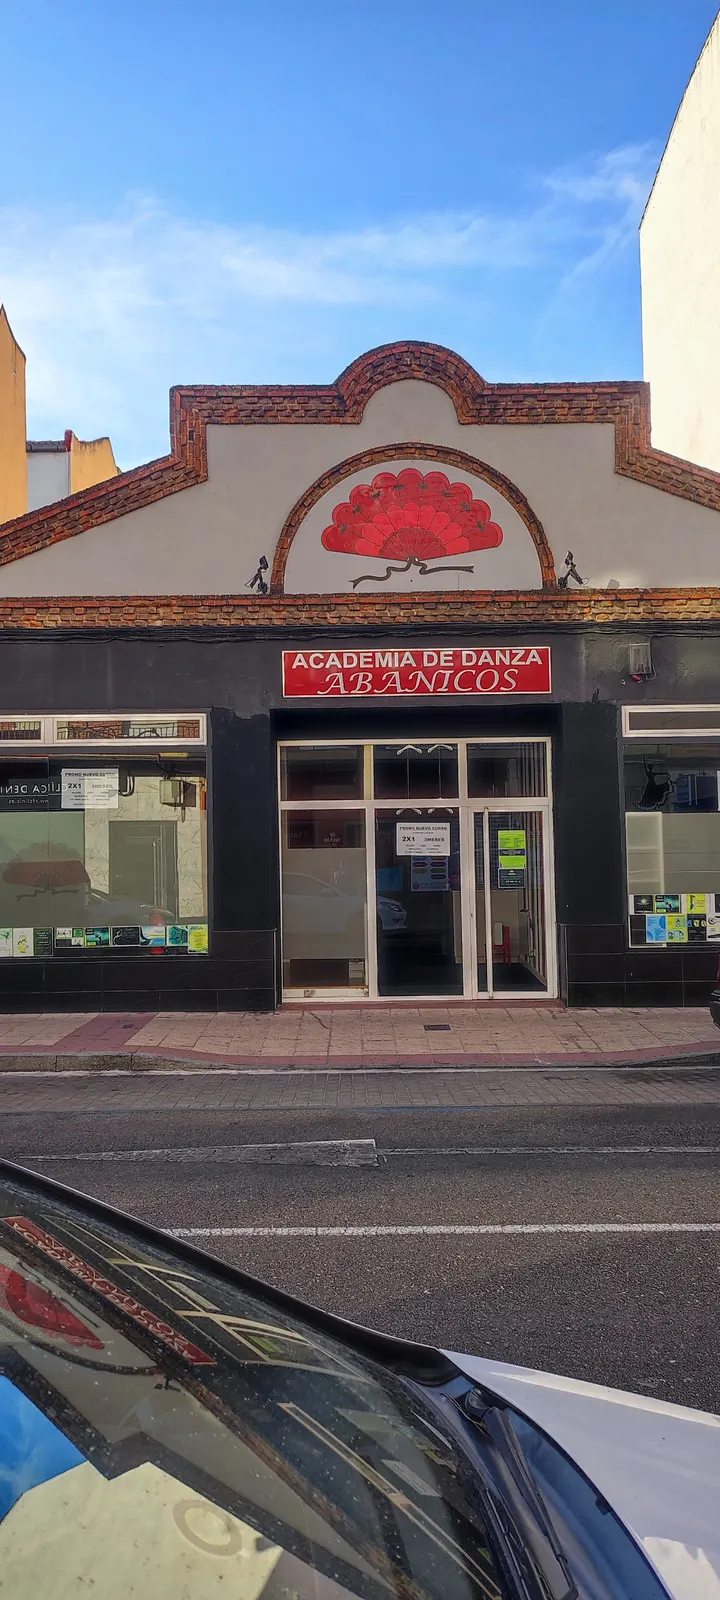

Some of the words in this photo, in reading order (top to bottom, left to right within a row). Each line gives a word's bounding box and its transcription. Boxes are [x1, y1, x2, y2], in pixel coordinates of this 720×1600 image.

[291, 650, 417, 669] ACADEMIA
[423, 650, 454, 668] DE
[461, 649, 543, 666] DANZA
[316, 668, 519, 695] ABANICOS
